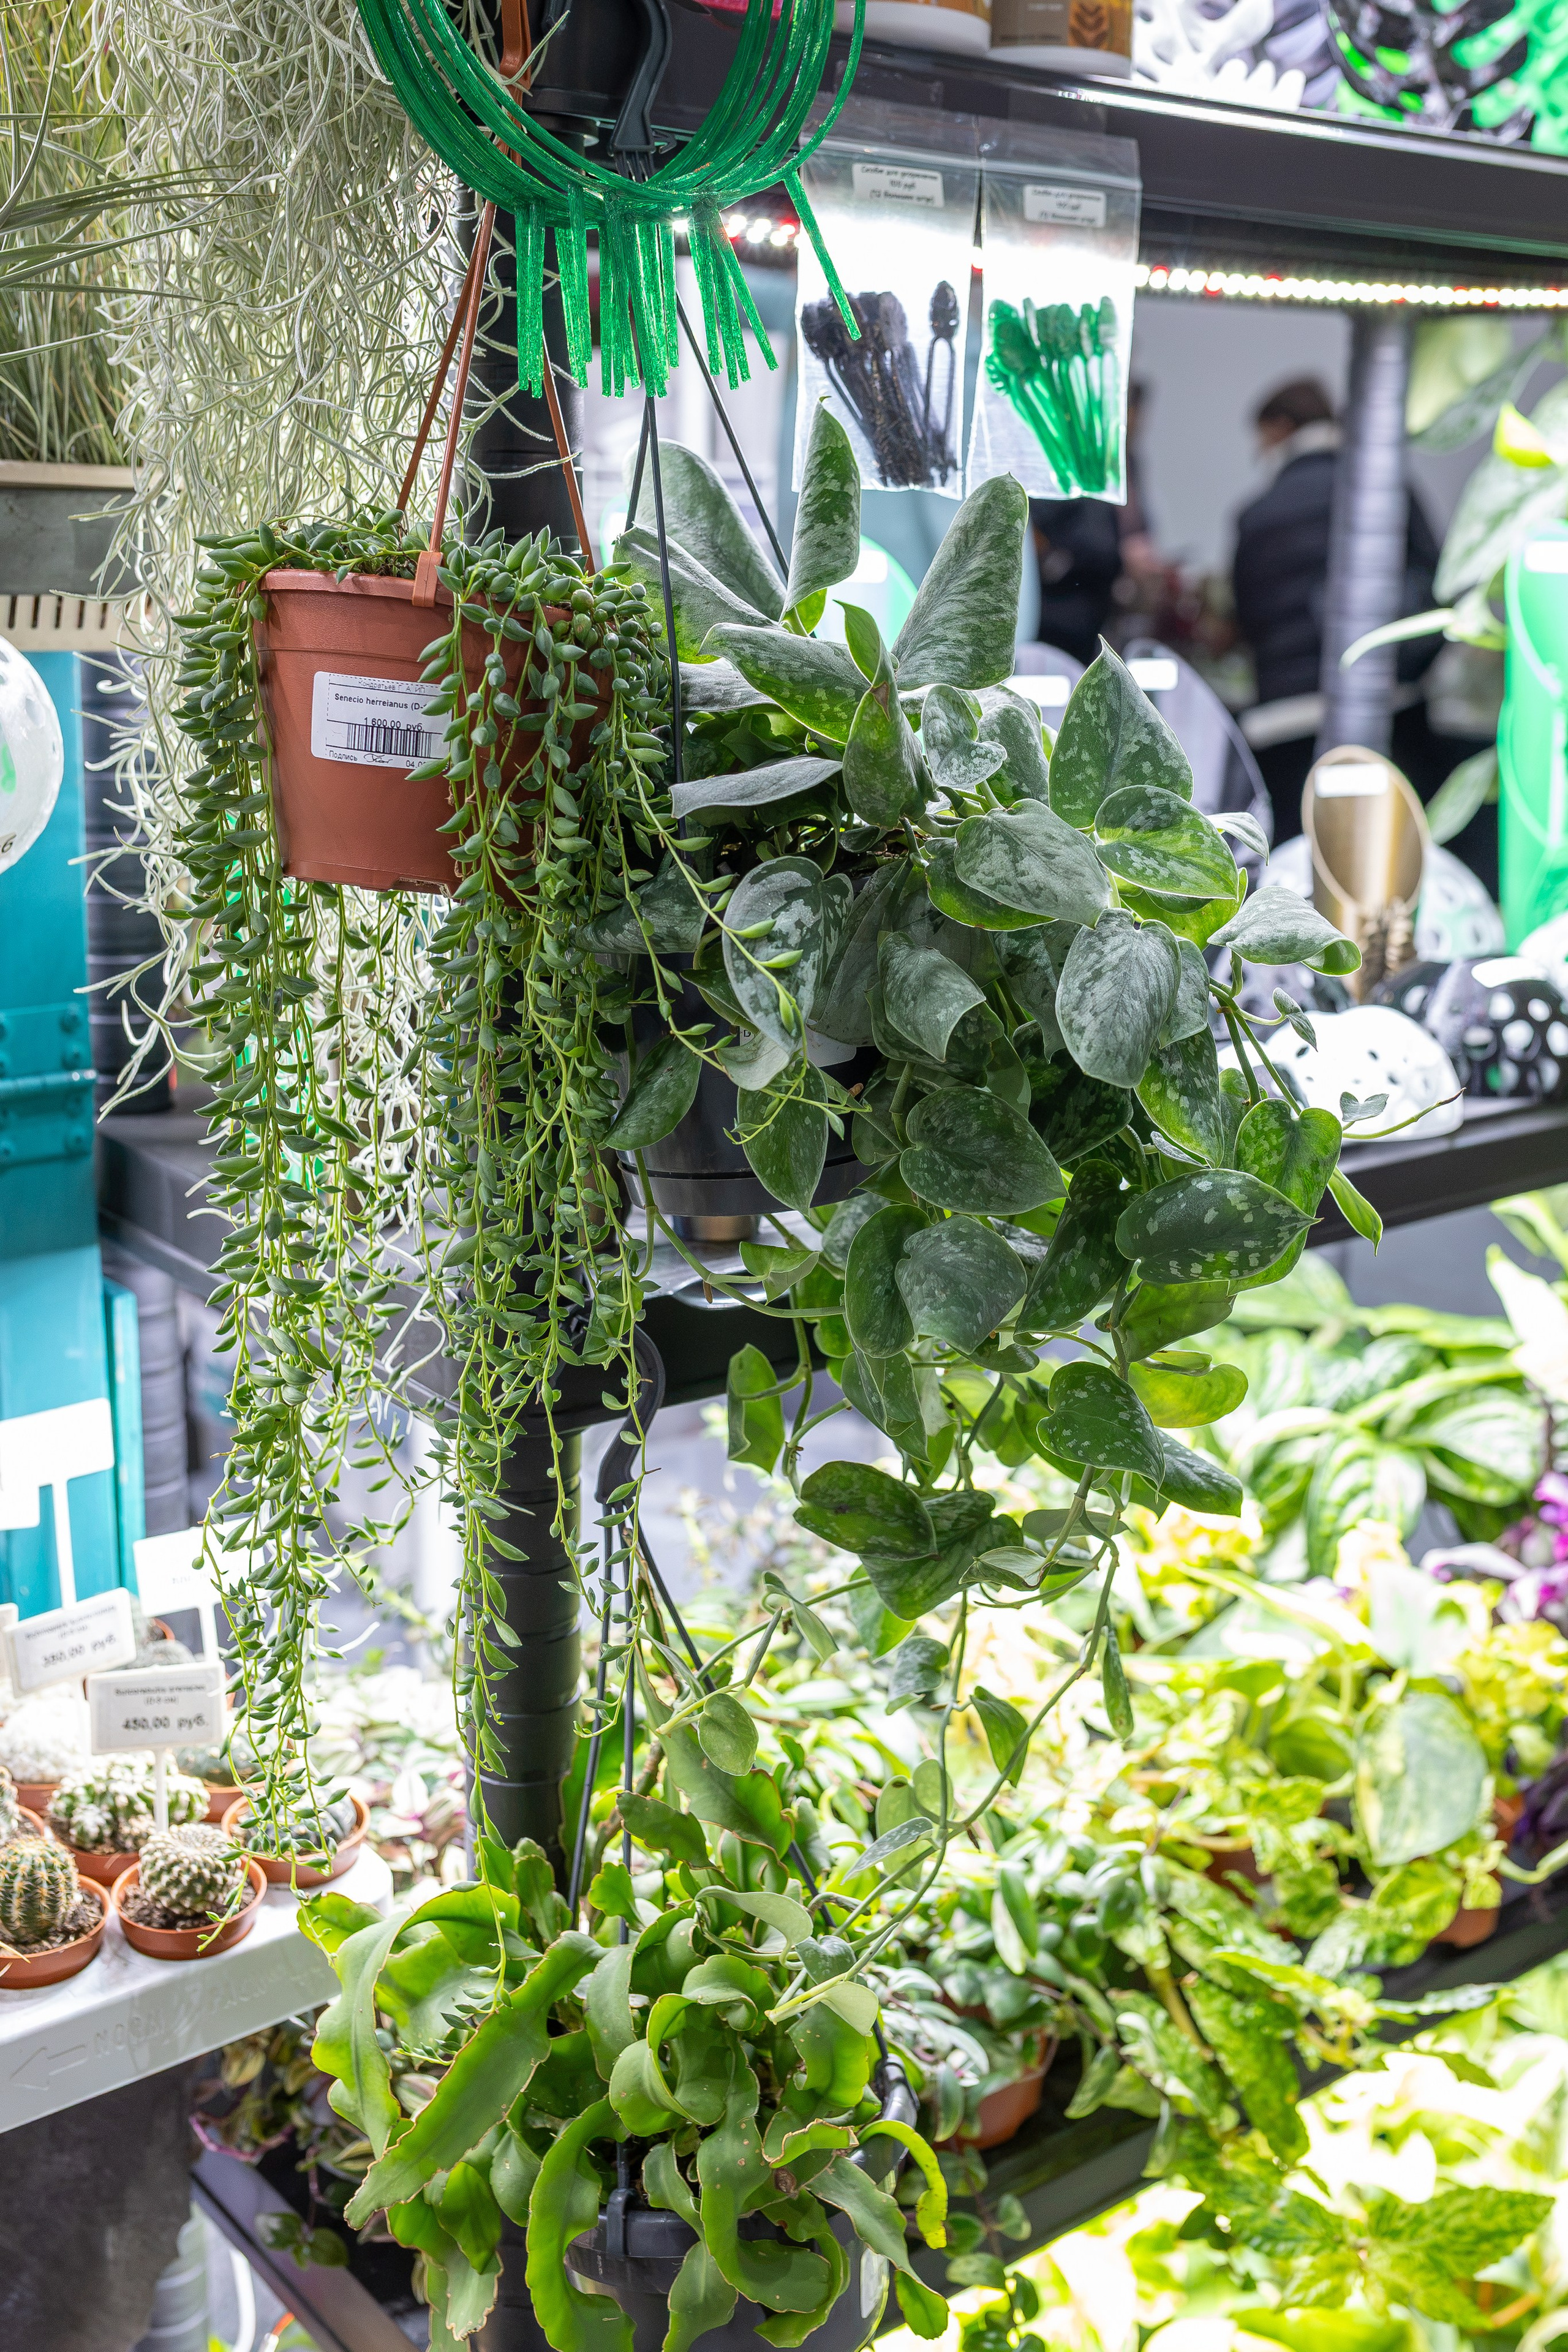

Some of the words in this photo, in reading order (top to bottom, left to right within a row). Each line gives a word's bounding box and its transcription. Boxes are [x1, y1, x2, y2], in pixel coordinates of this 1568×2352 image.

[334, 693, 363, 704] Senecio
[366, 697, 409, 709] herreianus
[329, 750, 358, 761] Подпись
